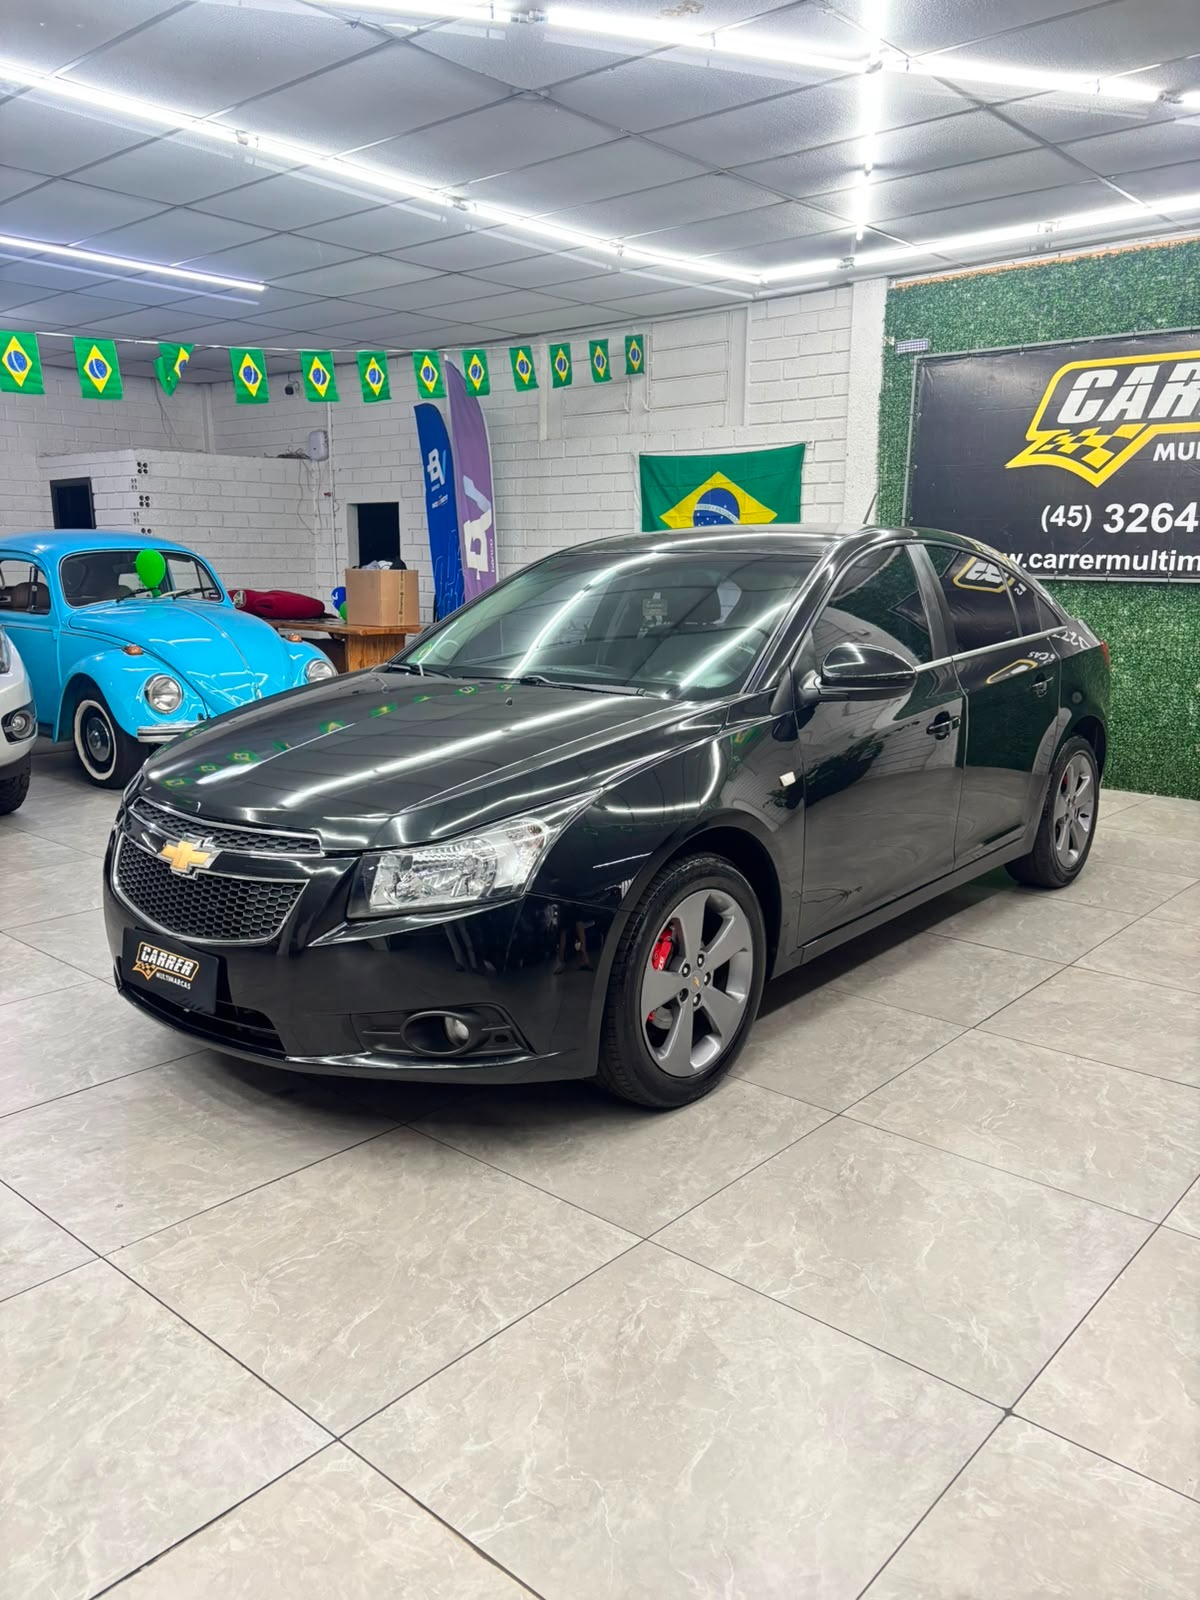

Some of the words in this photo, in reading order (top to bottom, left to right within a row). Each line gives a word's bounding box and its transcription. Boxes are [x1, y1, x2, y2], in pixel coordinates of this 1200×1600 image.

[1056, 362, 1200, 424] CAR
[1041, 505, 1092, 533] (45)
[1103, 502, 1199, 533] 3264
[141, 945, 194, 976] CARRER
[156, 972, 191, 990] MULTIMARCAS
